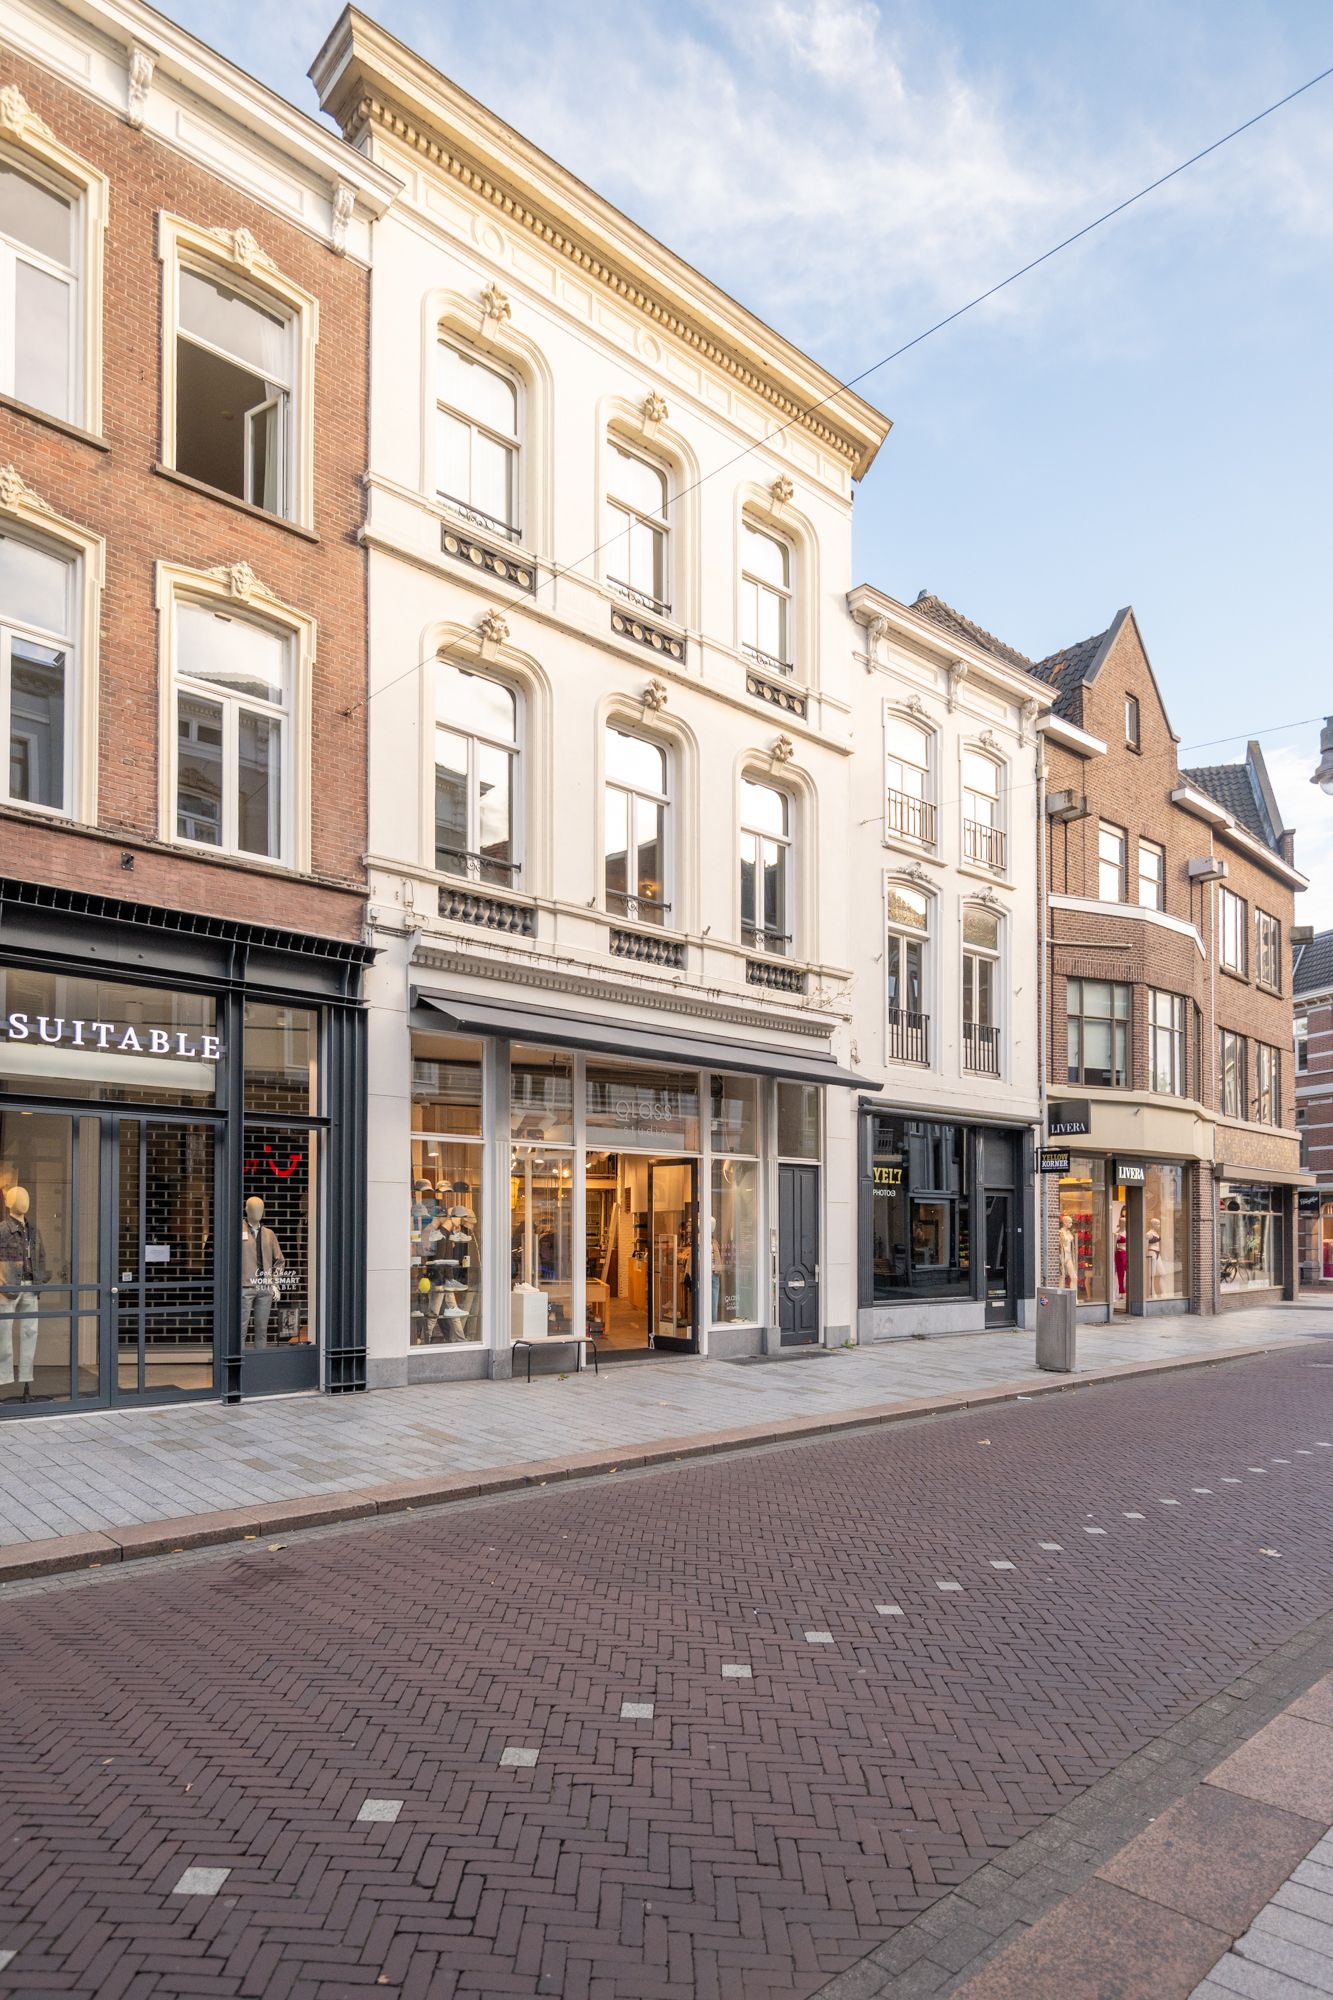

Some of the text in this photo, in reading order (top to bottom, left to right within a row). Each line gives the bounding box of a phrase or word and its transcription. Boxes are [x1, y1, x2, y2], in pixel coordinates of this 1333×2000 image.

[9, 1013, 220, 1059] SUITABLE
[1051, 1122, 1086, 1134] LIVERA
[1042, 1153, 1068, 1161] YELLOW
[1041, 1160, 1068, 1168] KORNER
[1118, 1166, 1145, 1180] LIVERA
[255, 1267, 297, 1278] Look Sharp
[250, 1277, 300, 1285] WORK SMART
